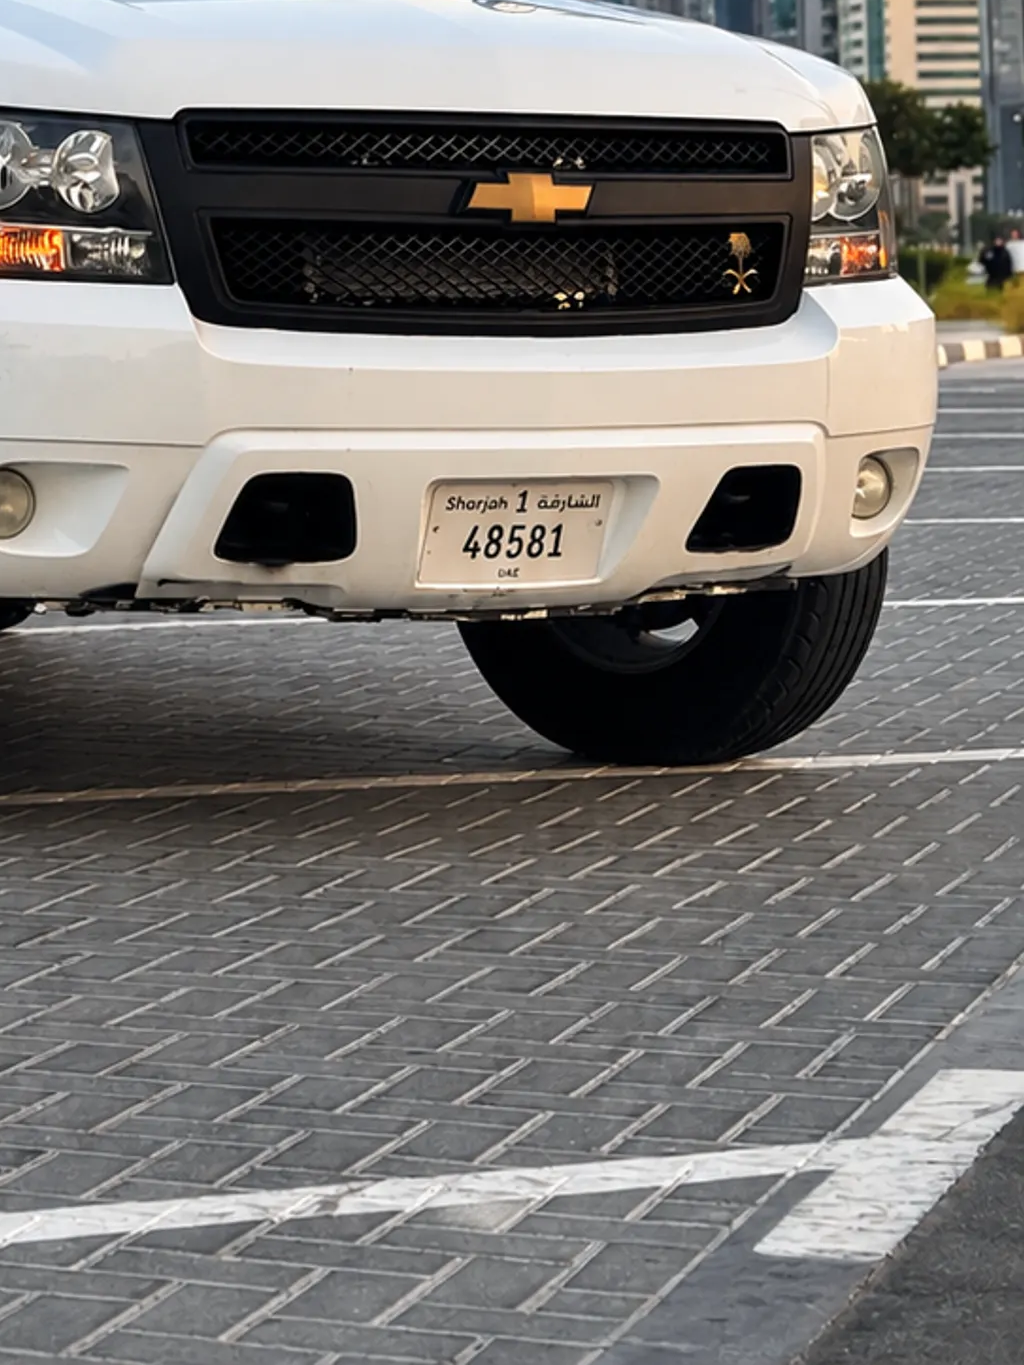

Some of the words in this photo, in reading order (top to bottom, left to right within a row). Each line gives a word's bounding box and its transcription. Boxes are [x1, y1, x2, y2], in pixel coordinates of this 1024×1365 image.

[445, 495, 508, 514] Sharjah
[516, 489, 528, 513] 1
[537, 493, 601, 513] الشارقة
[462, 523, 564, 560] 48581
